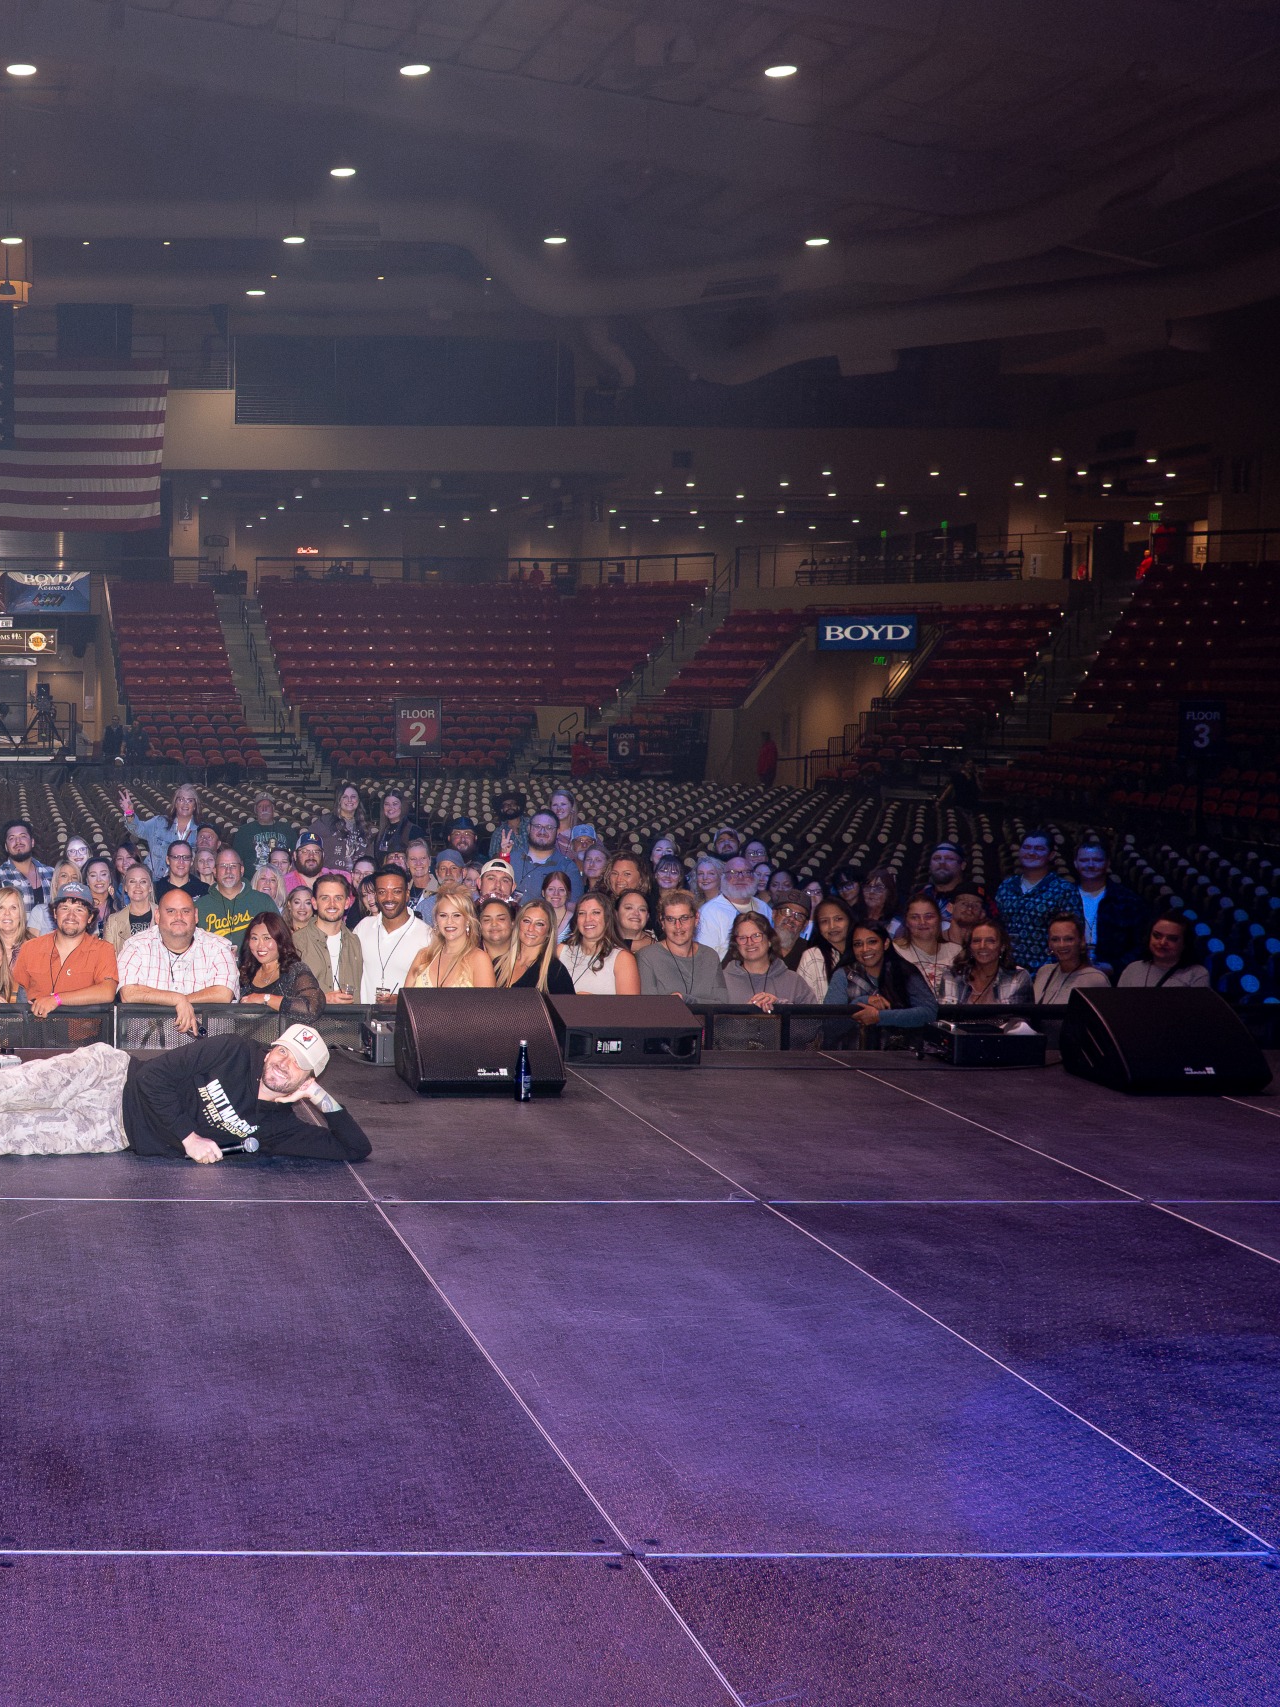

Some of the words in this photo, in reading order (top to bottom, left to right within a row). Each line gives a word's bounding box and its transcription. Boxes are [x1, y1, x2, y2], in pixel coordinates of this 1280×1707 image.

[23, 573, 72, 584] BOYD
[37, 580, 75, 591] Rewards
[824, 624, 910, 641] BOYD
[401, 709, 435, 719] FLOOR
[1186, 711, 1221, 720] FLOOR
[409, 721, 427, 746] 2
[1194, 723, 1210, 748] 3
[618, 741, 630, 756] 6
[205, 908, 254, 932] Packers
[206, 1078, 231, 1109] MATT
[197, 1086, 212, 1102] NOT
[205, 1101, 223, 1122] WHAT
